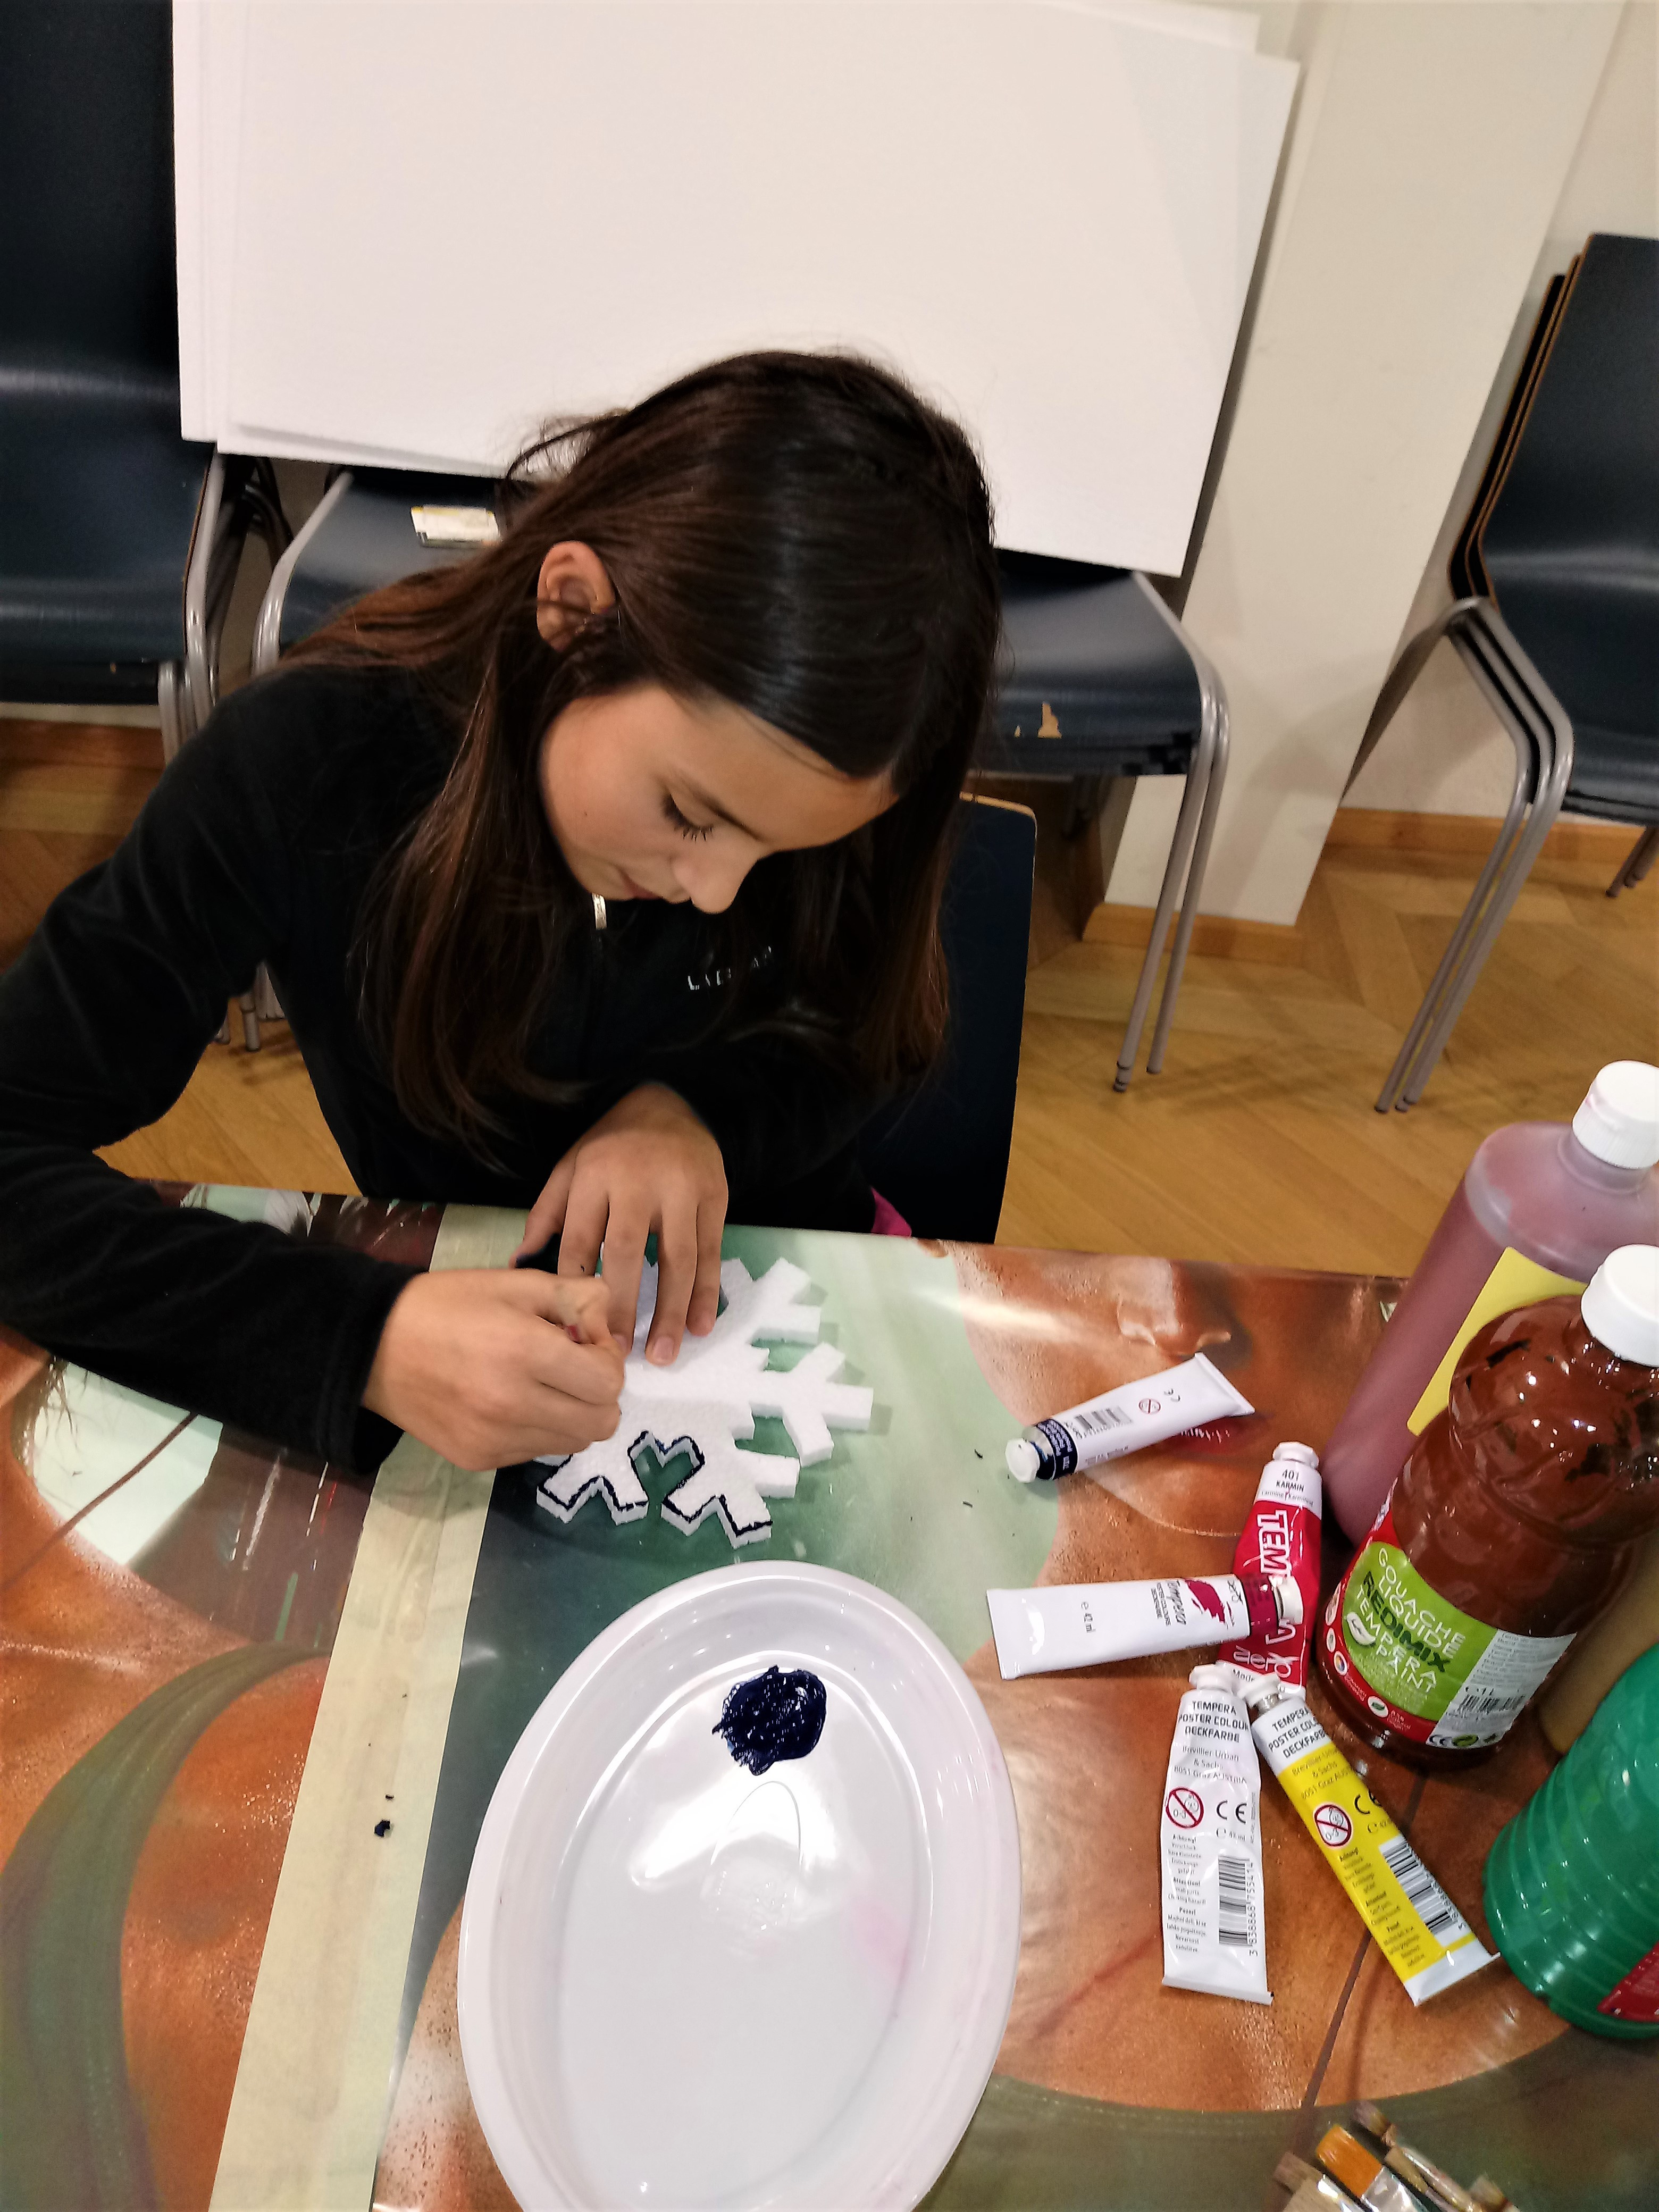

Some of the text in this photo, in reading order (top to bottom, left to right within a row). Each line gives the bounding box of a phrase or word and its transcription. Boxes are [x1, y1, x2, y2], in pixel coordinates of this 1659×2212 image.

[1276, 1480, 1304, 1493] KARMIN
[1282, 1469, 1299, 1481] 401
[1378, 1547, 1466, 1644] GOUACHE
[1363, 1571, 1451, 1672] REDIMIX
[1378, 1575, 1461, 1658] LIQUIDE
[1356, 1585, 1436, 1688] TEMPERA
[1376, 1644, 1436, 1692] PAINT
[1178, 1714, 1212, 1724] POSTER
[1192, 1701, 1237, 1715] TEMPERA
[1185, 1725, 1240, 1743] DECKFARBE
[1268, 1728, 1301, 1753] POSTER
[1216, 1800, 1247, 1824] CE
